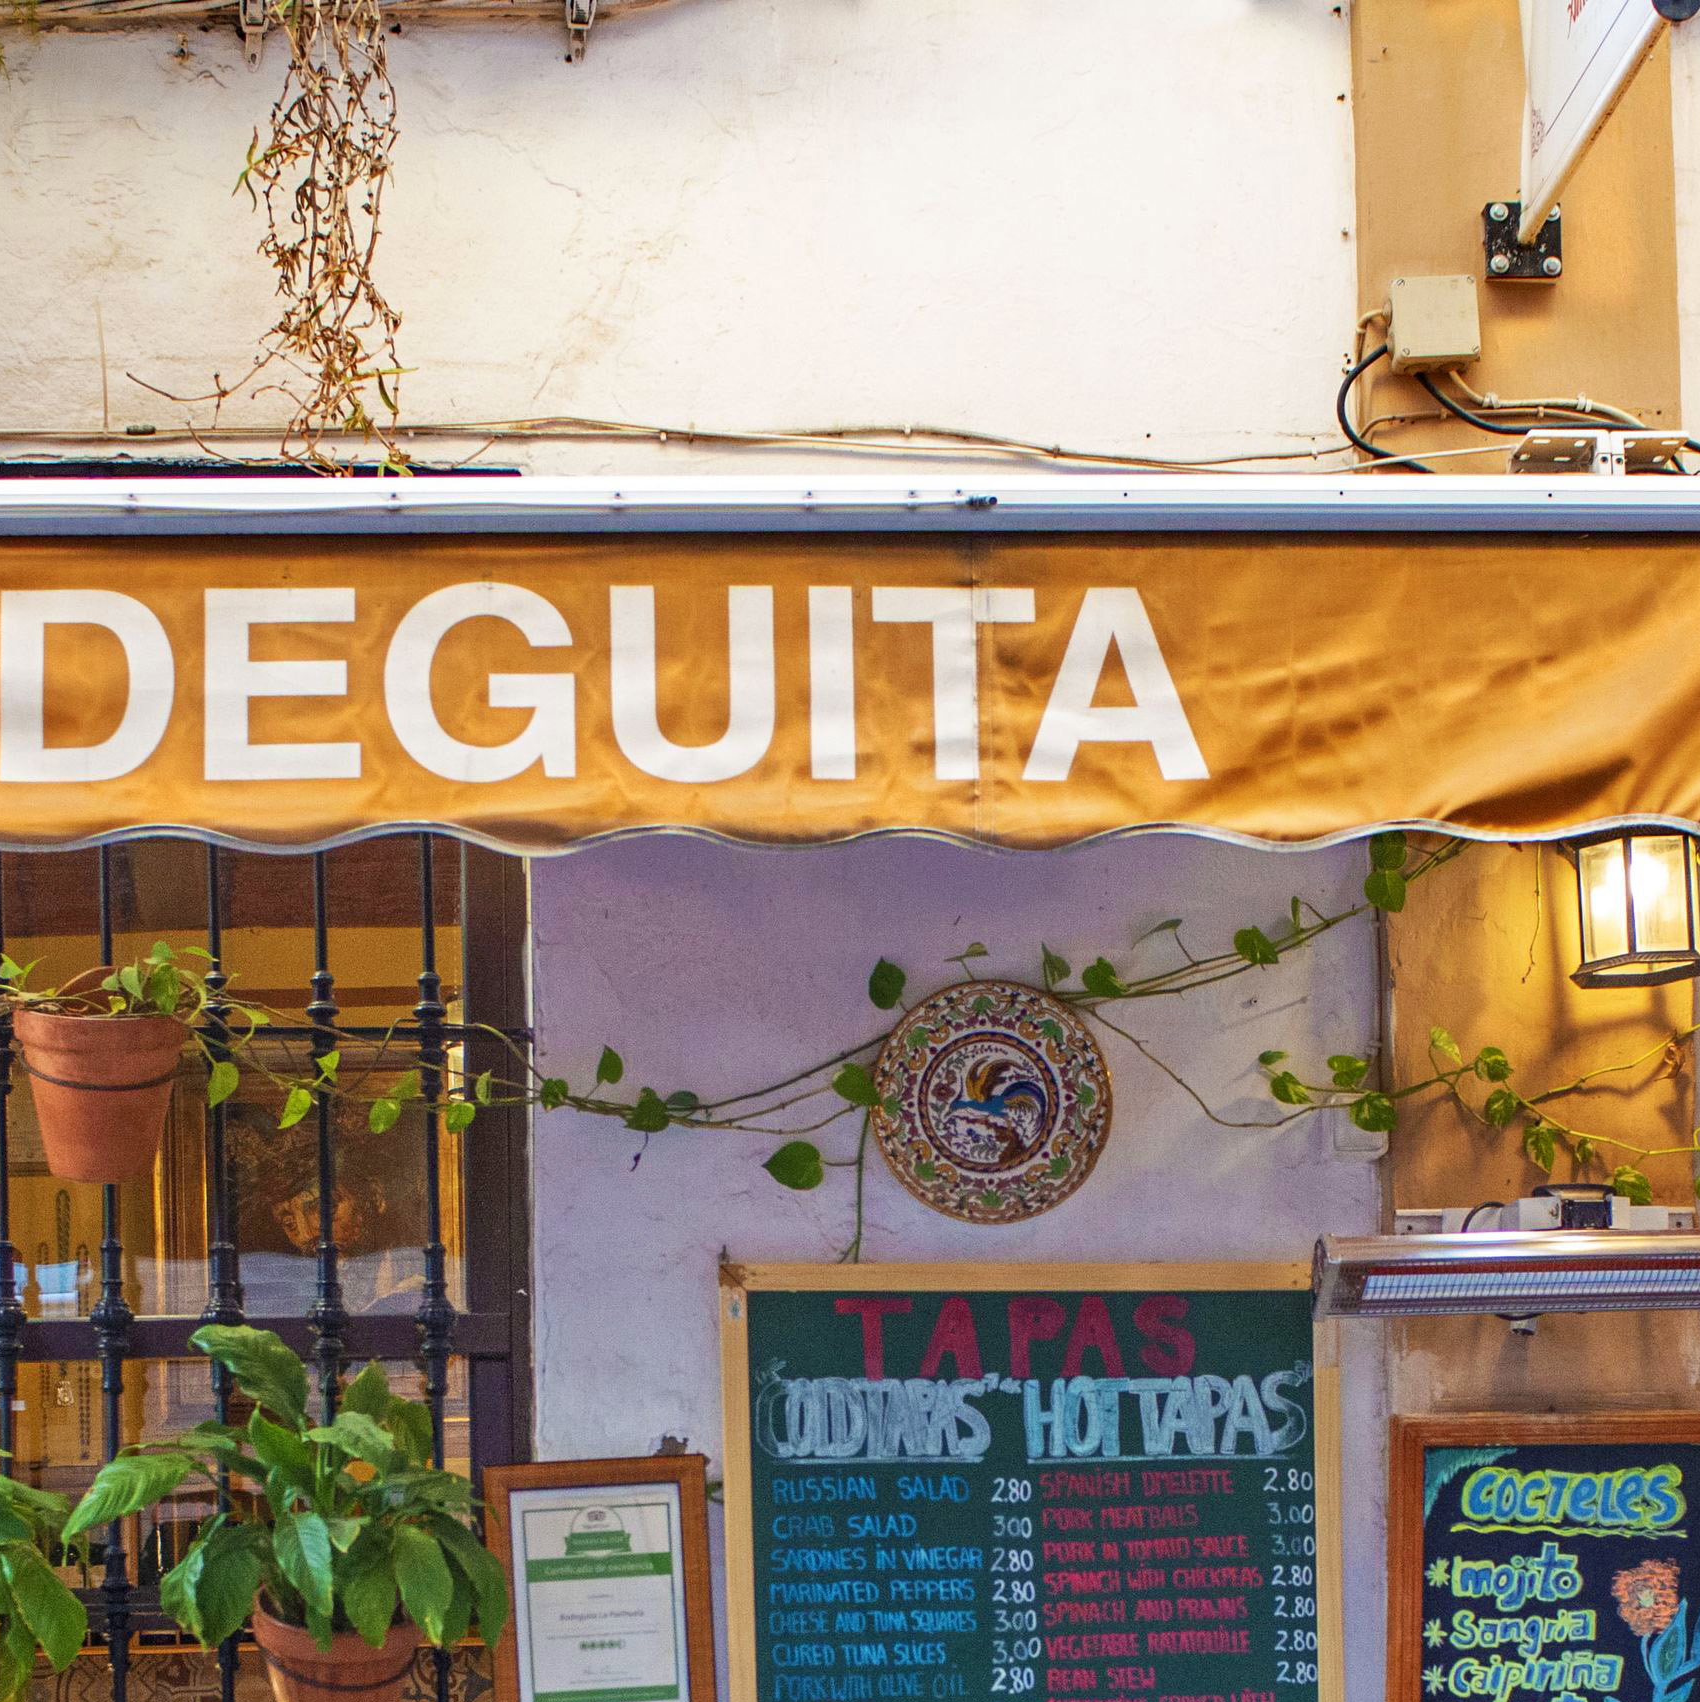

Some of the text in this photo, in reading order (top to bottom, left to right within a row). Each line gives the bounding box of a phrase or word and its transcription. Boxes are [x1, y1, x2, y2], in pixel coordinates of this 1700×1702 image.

[834, 1296, 1196, 1380] TAPAS
[897, 1475, 970, 1504] SALAD
[991, 1478, 1031, 1503] 2.80
[1263, 1468, 1313, 1492] 2.80
[772, 1514, 917, 1539] CRAB SALAD
[1193, 1536, 1250, 1559] SAUCE
[1271, 1565, 1313, 1586] 2.80
[1451, 1542, 1584, 1611] mojito
[769, 1578, 1035, 1604] MARINATED PEPPERS 2.80
[835, 1610, 866, 1633] AND
[868, 1610, 908, 1632] TUNA
[911, 1610, 978, 1634] SQUARES
[1134, 1600, 1174, 1622] AND
[1273, 1595, 1315, 1617] 2.80
[1274, 1630, 1317, 1651] 2.80
[1450, 1609, 1596, 1658] Sangria
[772, 1642, 835, 1668] CURED
[841, 1642, 887, 1665] TUNA
[992, 1637, 1041, 1664] 3.00
[990, 1667, 1034, 1694] 2.80
[1107, 1661, 1317, 1689] STEW 2.80
